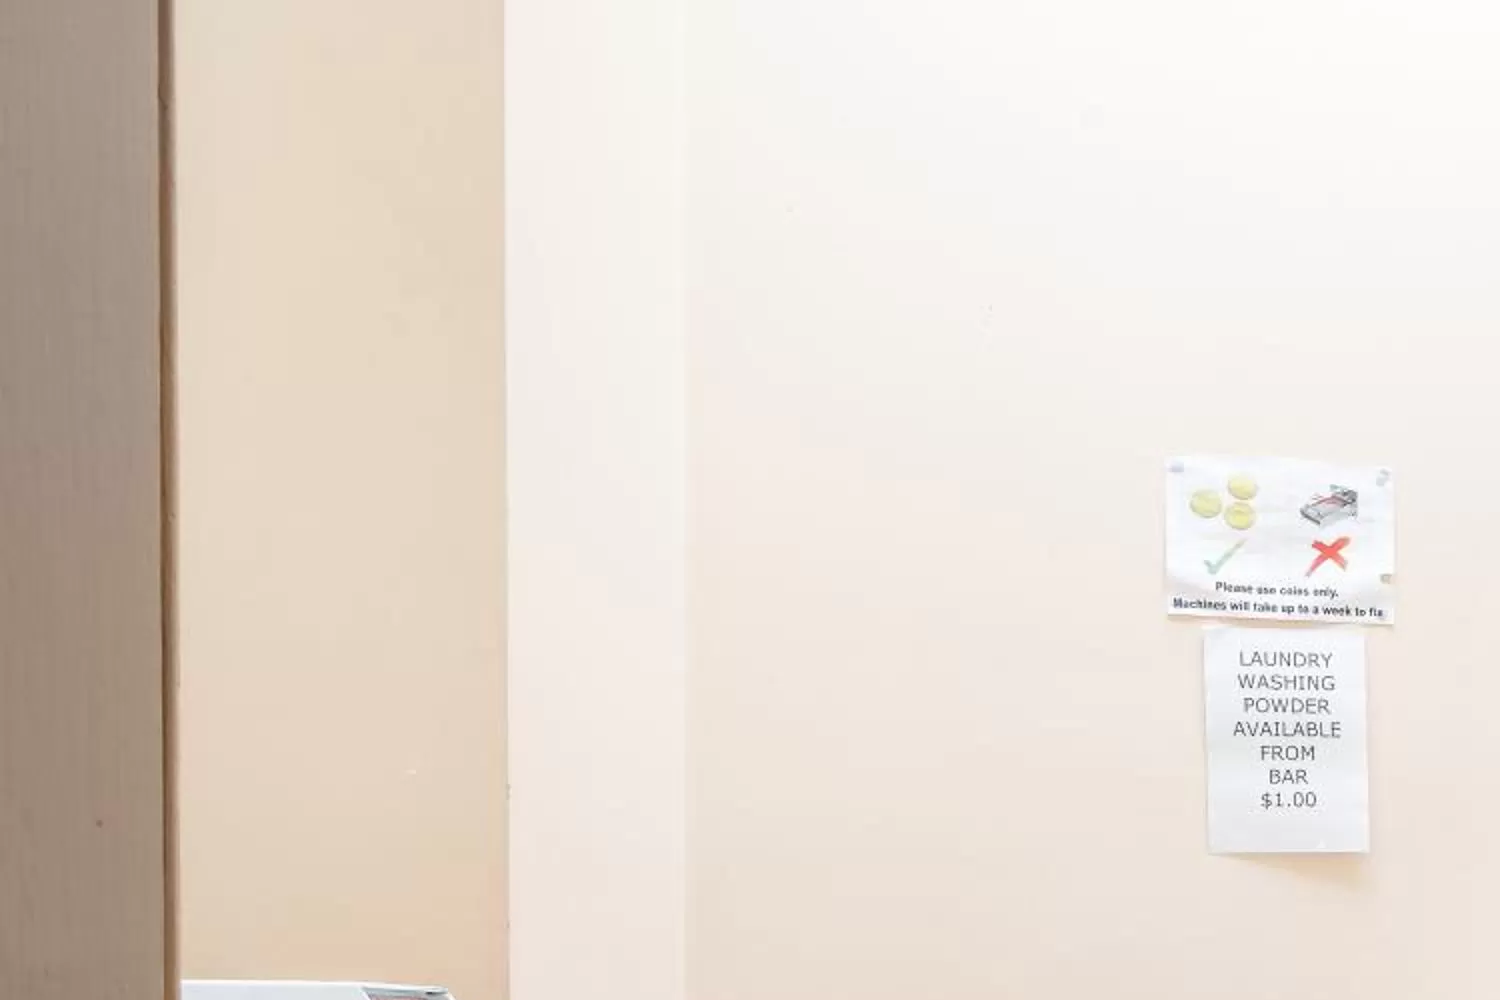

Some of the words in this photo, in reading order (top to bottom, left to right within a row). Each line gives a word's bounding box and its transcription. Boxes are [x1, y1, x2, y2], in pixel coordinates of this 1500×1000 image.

[1215, 581, 1253, 594] Please
[1279, 586, 1309, 597] coins
[1313, 587, 1339, 600] only.
[1173, 597, 1227, 611] Machines
[1229, 600, 1250, 611] will
[1253, 601, 1279, 613] take
[1281, 605, 1295, 614] up
[1298, 604, 1309, 614] to
[1312, 606, 1319, 614] a
[1322, 605, 1352, 616] week
[1355, 607, 1367, 617] to
[1239, 651, 1333, 668] LAUNDRY
[1237, 673, 1336, 691] WASHING
[1243, 697, 1331, 715] POWDER
[1233, 721, 1342, 738] AVAILABLE
[1260, 745, 1316, 761] FROM
[1269, 769, 1309, 785] BAR
[1260, 791, 1318, 810] $1.00
